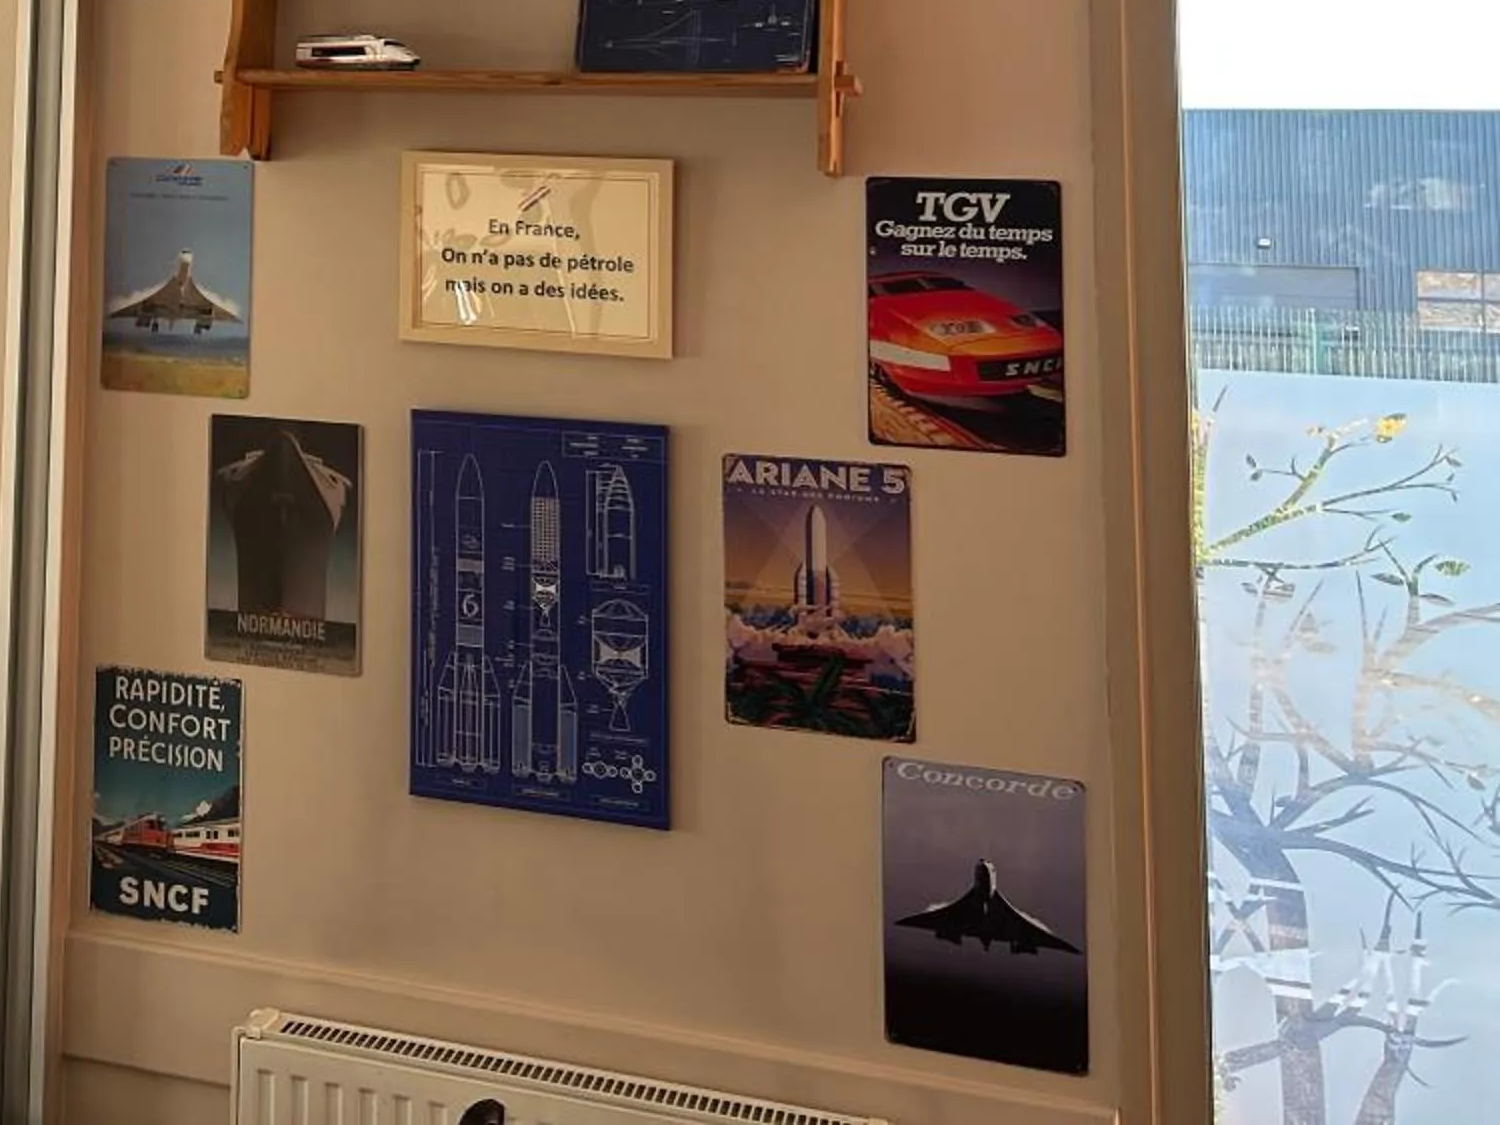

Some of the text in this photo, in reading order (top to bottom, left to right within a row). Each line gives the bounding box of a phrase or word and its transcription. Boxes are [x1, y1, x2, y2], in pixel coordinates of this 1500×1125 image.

[916, 191, 1010, 223] TGV
[489, 218, 580, 240] En France,
[875, 220, 1053, 245] Gagnez du temps
[441, 248, 467, 264] On
[504, 253, 535, 270] pas
[539, 252, 562, 268] de
[567, 254, 635, 274] pétrole
[901, 241, 1028, 263] sur le temps.
[445, 277, 625, 302] mais on a des idées.
[727, 459, 905, 494] ARIANE 5
[237, 613, 326, 641] NORMANDIE
[116, 676, 225, 713] RAPIDITÉ,
[109, 704, 231, 741] CONFORT
[109, 735, 224, 772] PRÉCISION
[897, 762, 1077, 801] Concorde
[120, 876, 209, 914] SNCF
